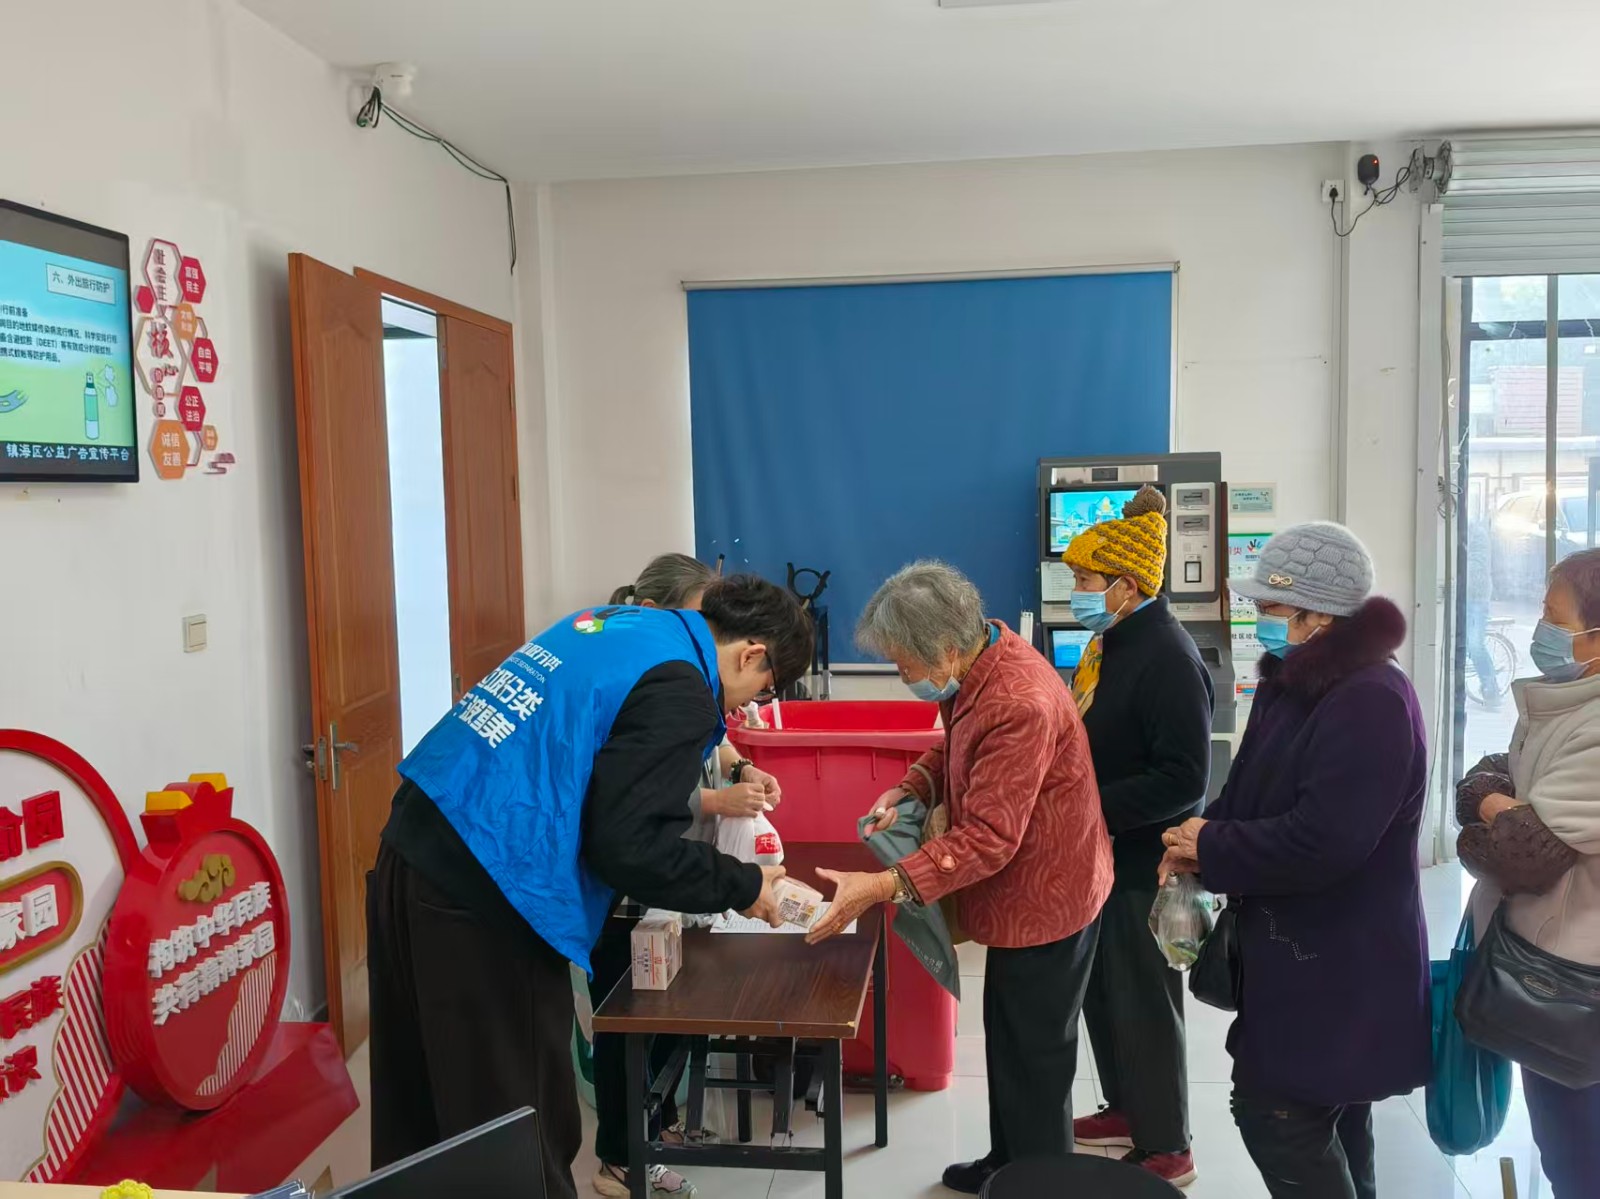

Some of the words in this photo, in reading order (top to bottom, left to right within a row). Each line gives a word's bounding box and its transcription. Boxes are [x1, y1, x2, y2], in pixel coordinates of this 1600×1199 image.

[0, 304, 28, 318] 行前准备
[197, 346, 212, 359] 自由
[161, 432, 180, 447] 诚信
[6, 442, 130, 461] 镇海区公益广告宣传平台
[163, 451, 181, 466] 友善
[147, 881, 272, 978] 构筑中华民族
[152, 921, 276, 1026] 共有精神家园
